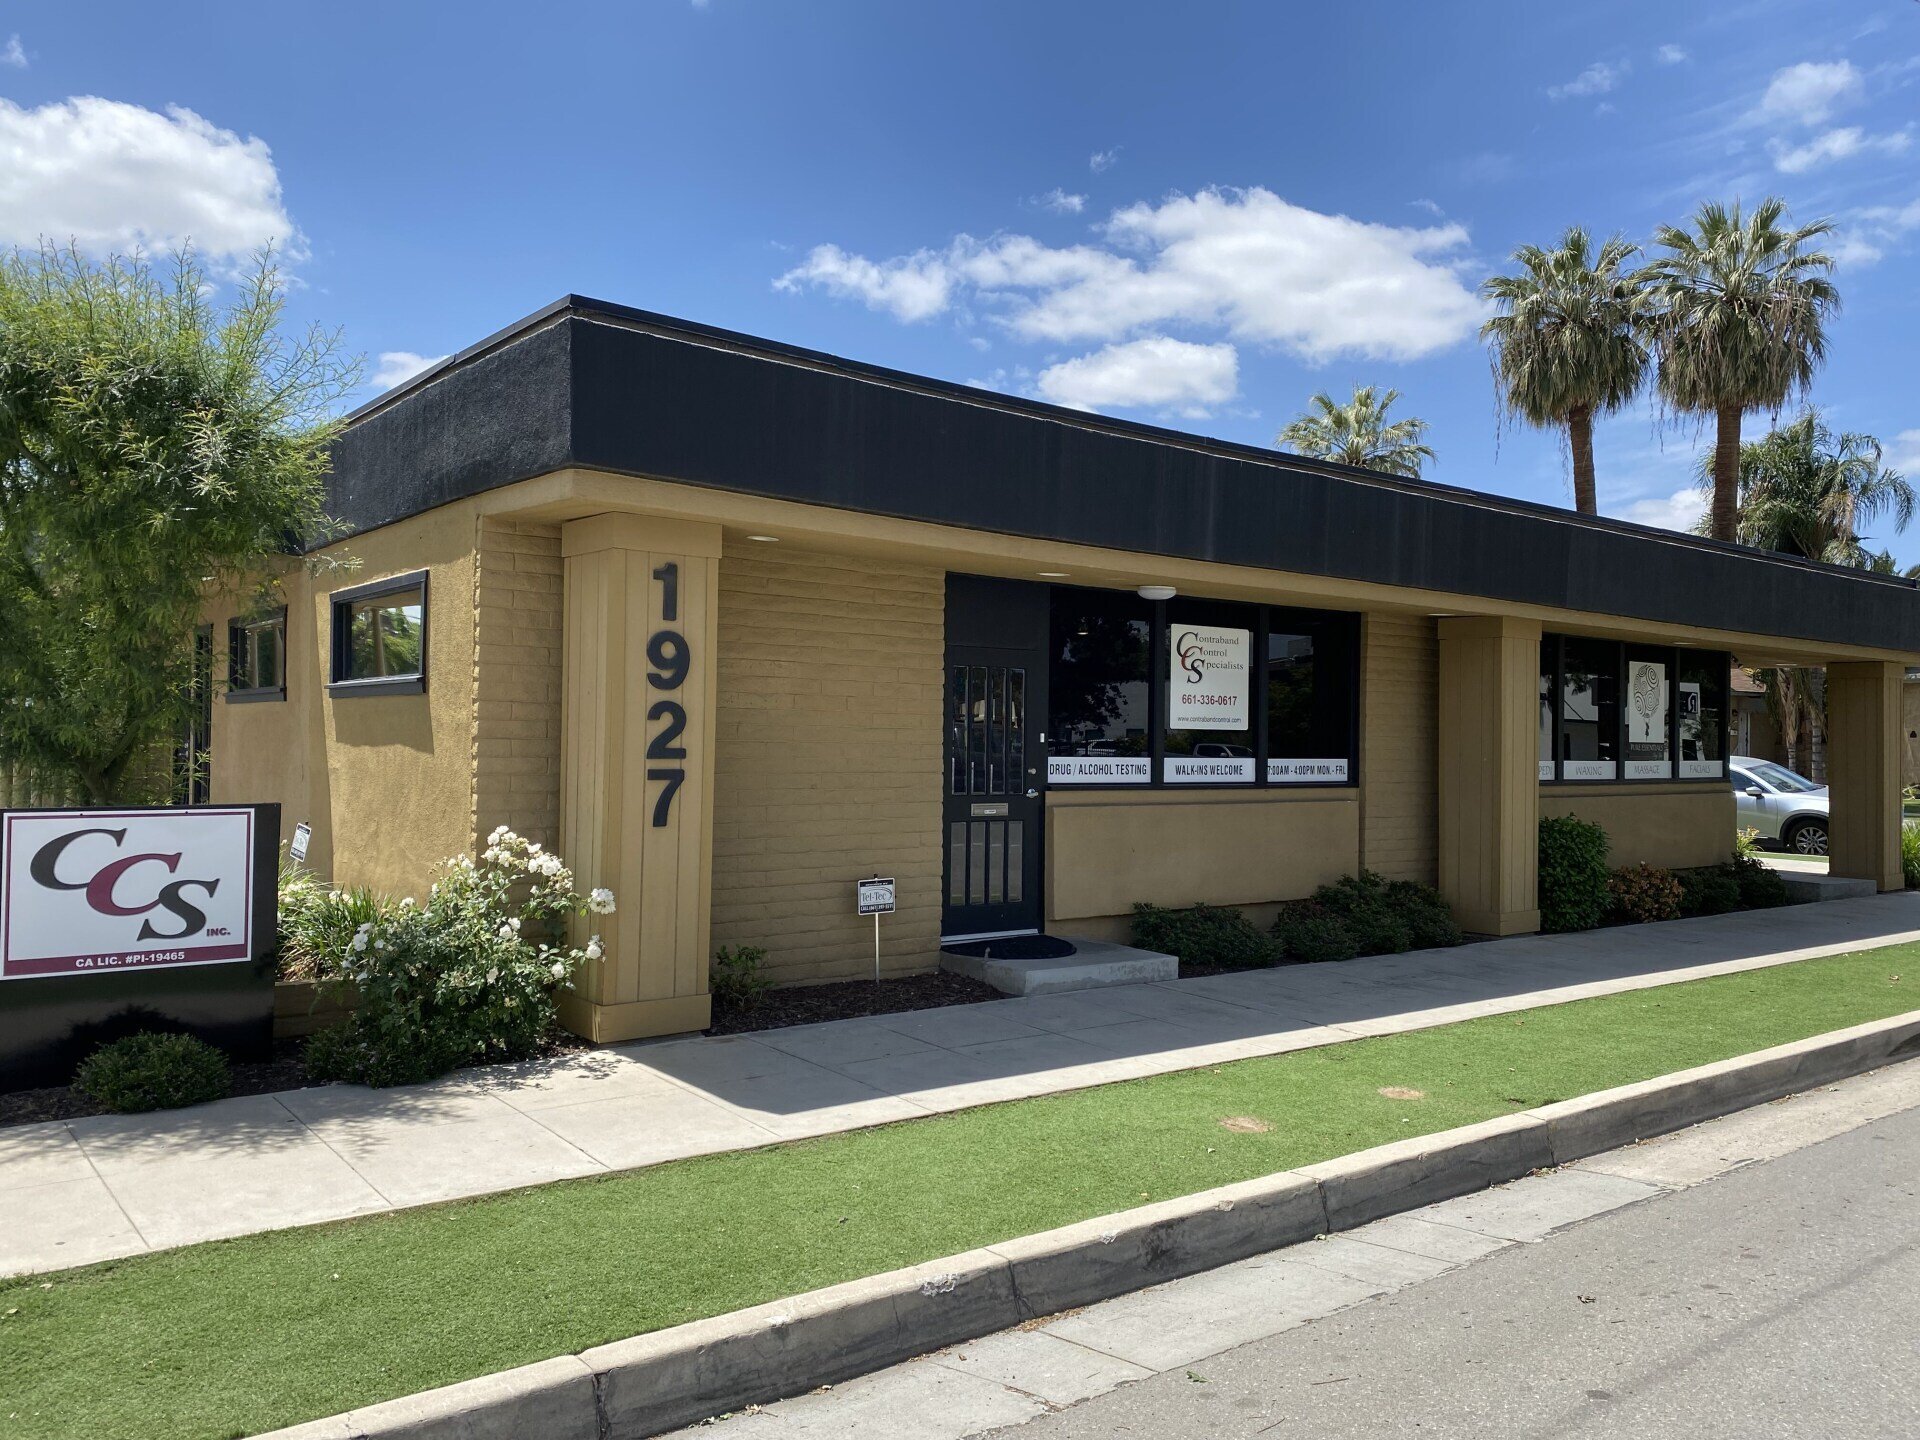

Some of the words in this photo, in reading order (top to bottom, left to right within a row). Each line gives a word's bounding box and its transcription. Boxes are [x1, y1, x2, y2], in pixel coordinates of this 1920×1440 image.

[1176, 631, 1239, 657] Contraband
[1181, 645, 1228, 671] Control
[1187, 658, 1244, 684] Specialists
[646, 562, 690, 827] 1927
[1181, 693, 1238, 706] 661-336-0617
[1049, 763, 1072, 775] DRUG
[1078, 763, 1114, 775] ALCOHOL
[1115, 764, 1147, 775] TESTING
[1175, 764, 1208, 776] WALK-INS
[1209, 764, 1243, 776] WELCOME
[1575, 766, 1603, 776] WAXING
[1634, 764, 1660, 775] MASSAGE
[1689, 764, 1711, 774] FACIALS
[30, 827, 220, 941] CCS
[206, 927, 231, 937] INC.
[75, 958, 93, 968] CA
[97, 956, 122, 966] LIC.
[125, 951, 185, 964] #PI-19465
